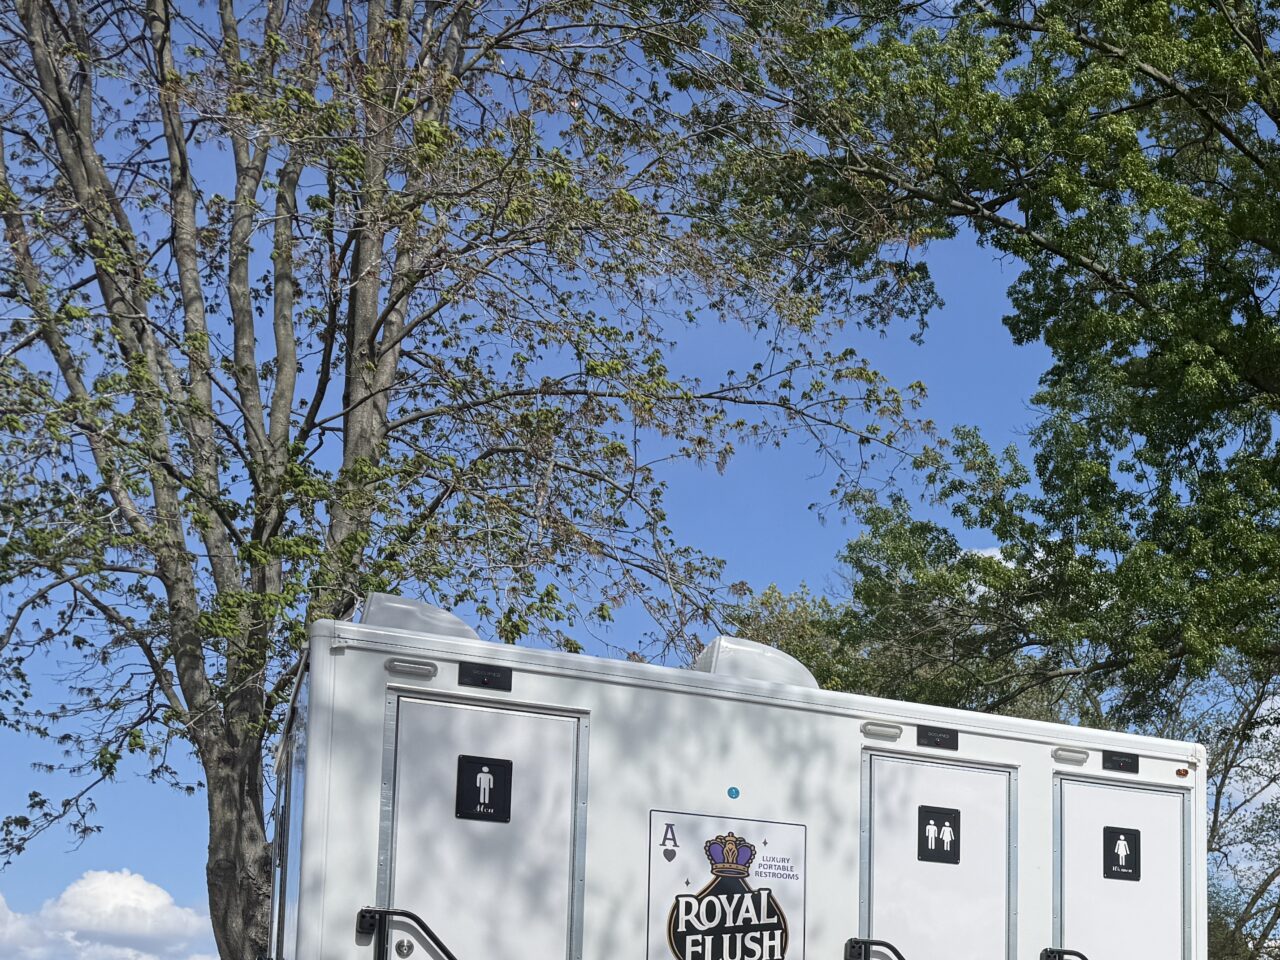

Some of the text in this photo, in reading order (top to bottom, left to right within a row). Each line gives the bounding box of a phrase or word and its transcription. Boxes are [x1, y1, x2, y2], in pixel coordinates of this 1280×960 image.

[659, 822, 680, 848] A
[762, 855, 791, 864] LUXURY
[758, 863, 795, 872] PORTABLE
[754, 870, 800, 881] RESTROOMS
[676, 890, 778, 932] ROYAL
